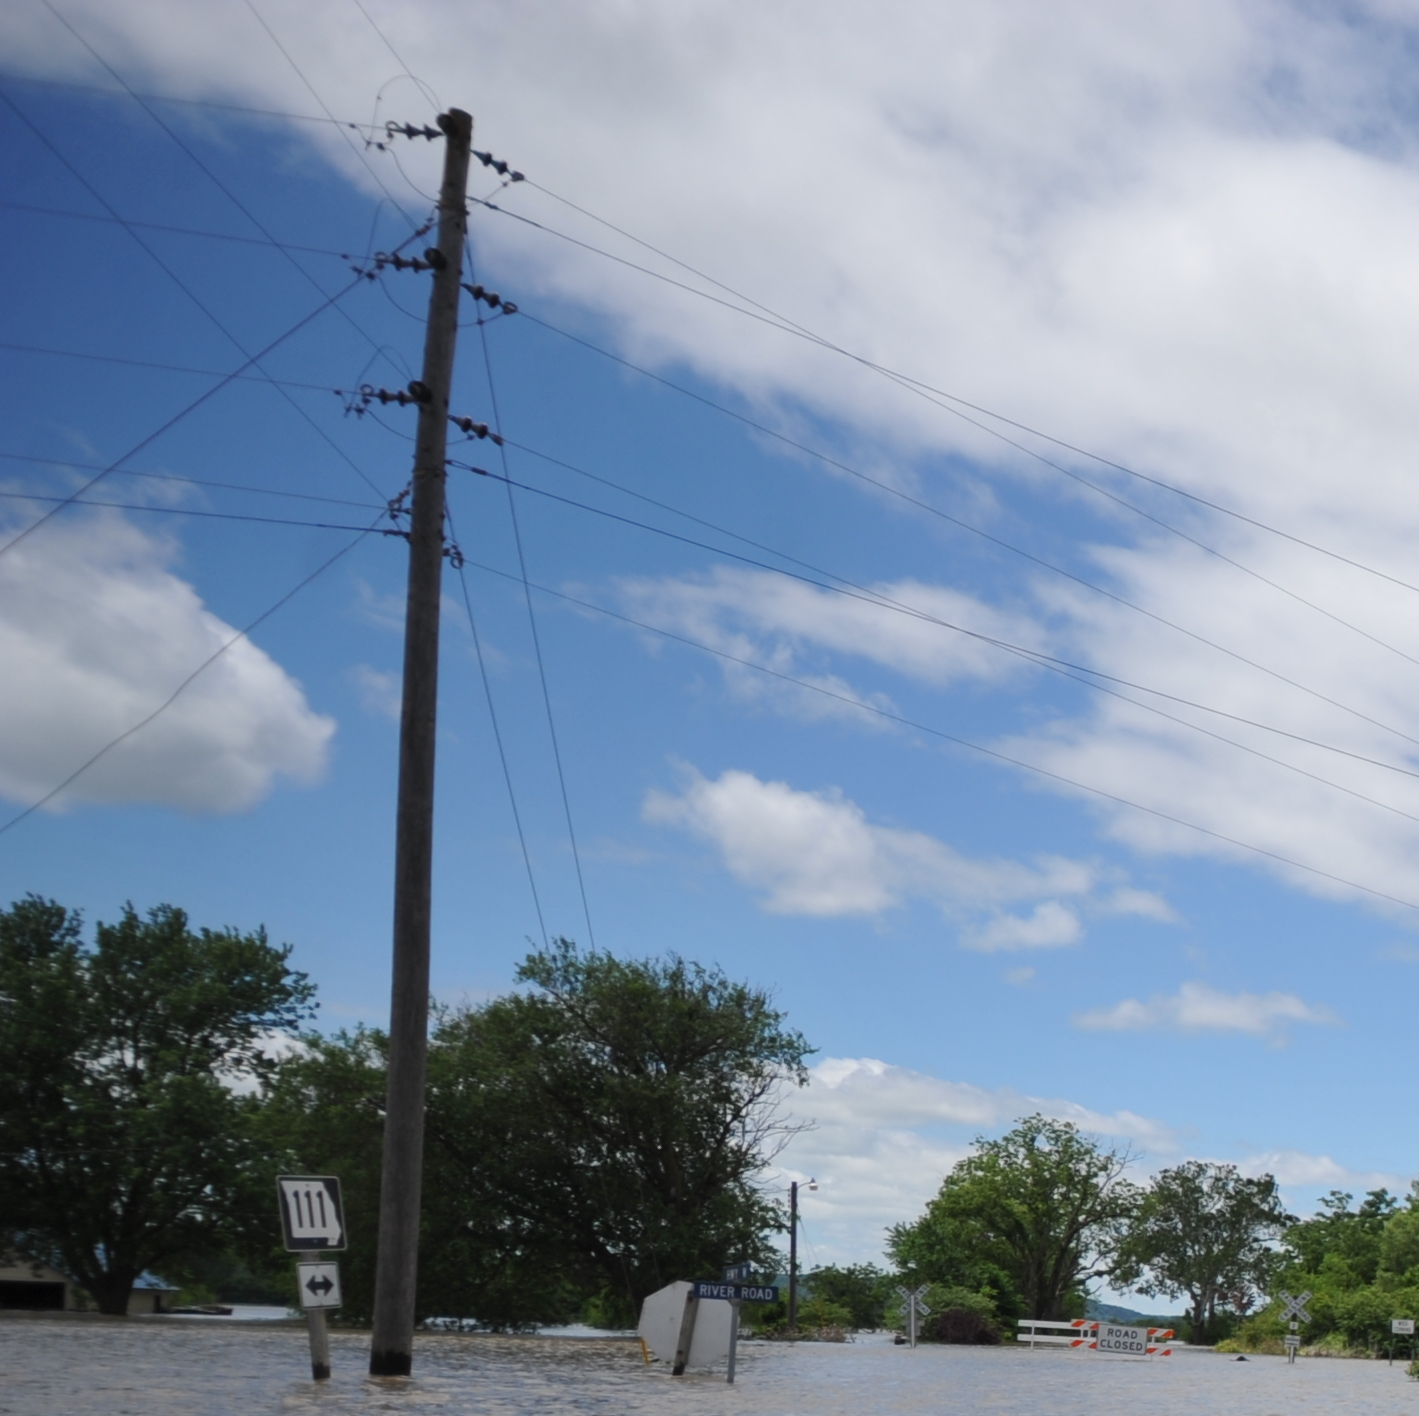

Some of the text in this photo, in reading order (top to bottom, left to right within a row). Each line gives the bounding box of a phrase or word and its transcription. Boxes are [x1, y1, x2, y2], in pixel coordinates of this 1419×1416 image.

[292, 1189, 327, 1229] 111
[699, 1284, 773, 1300] RIVER ROAD
[1107, 1328, 1138, 1339] ROAD
[1100, 1339, 1143, 1352] CLOSED
